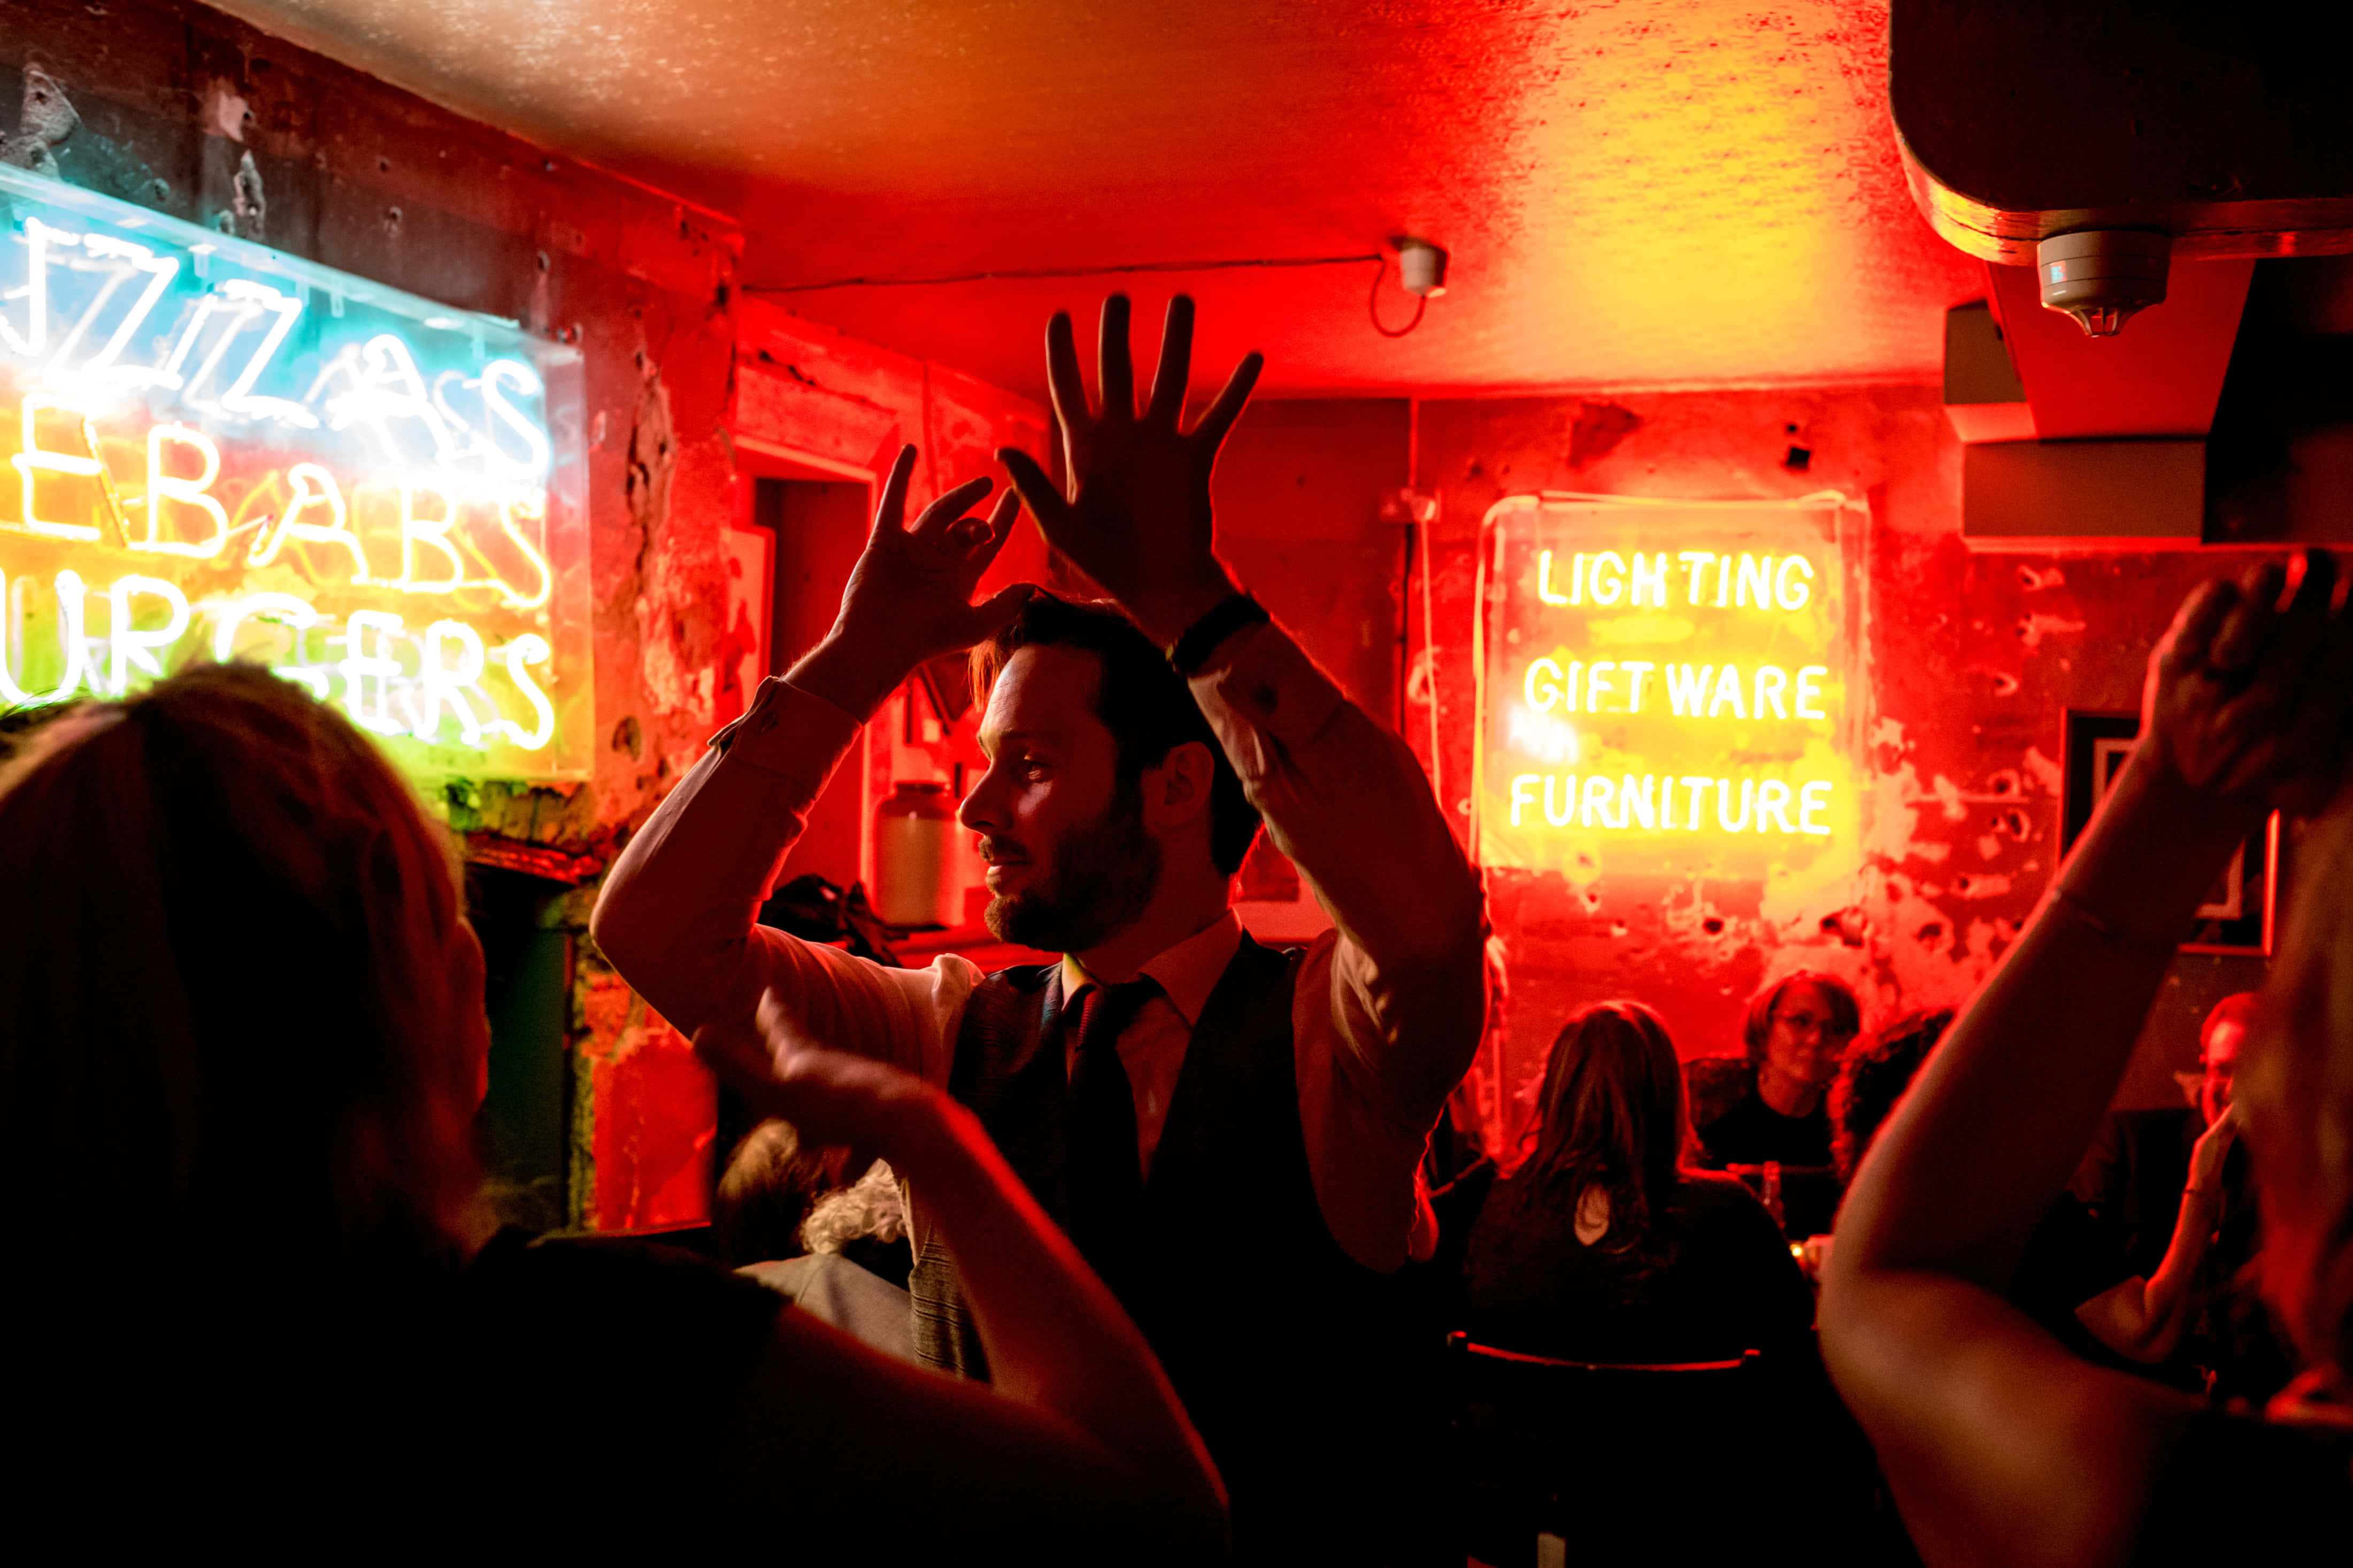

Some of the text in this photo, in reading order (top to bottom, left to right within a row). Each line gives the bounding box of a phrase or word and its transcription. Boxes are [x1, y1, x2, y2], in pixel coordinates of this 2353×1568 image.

[11, 392, 551, 609] EBABS
[1538, 550, 1814, 610] LIGHTING
[1510, 774, 1833, 835] FURNITURE
